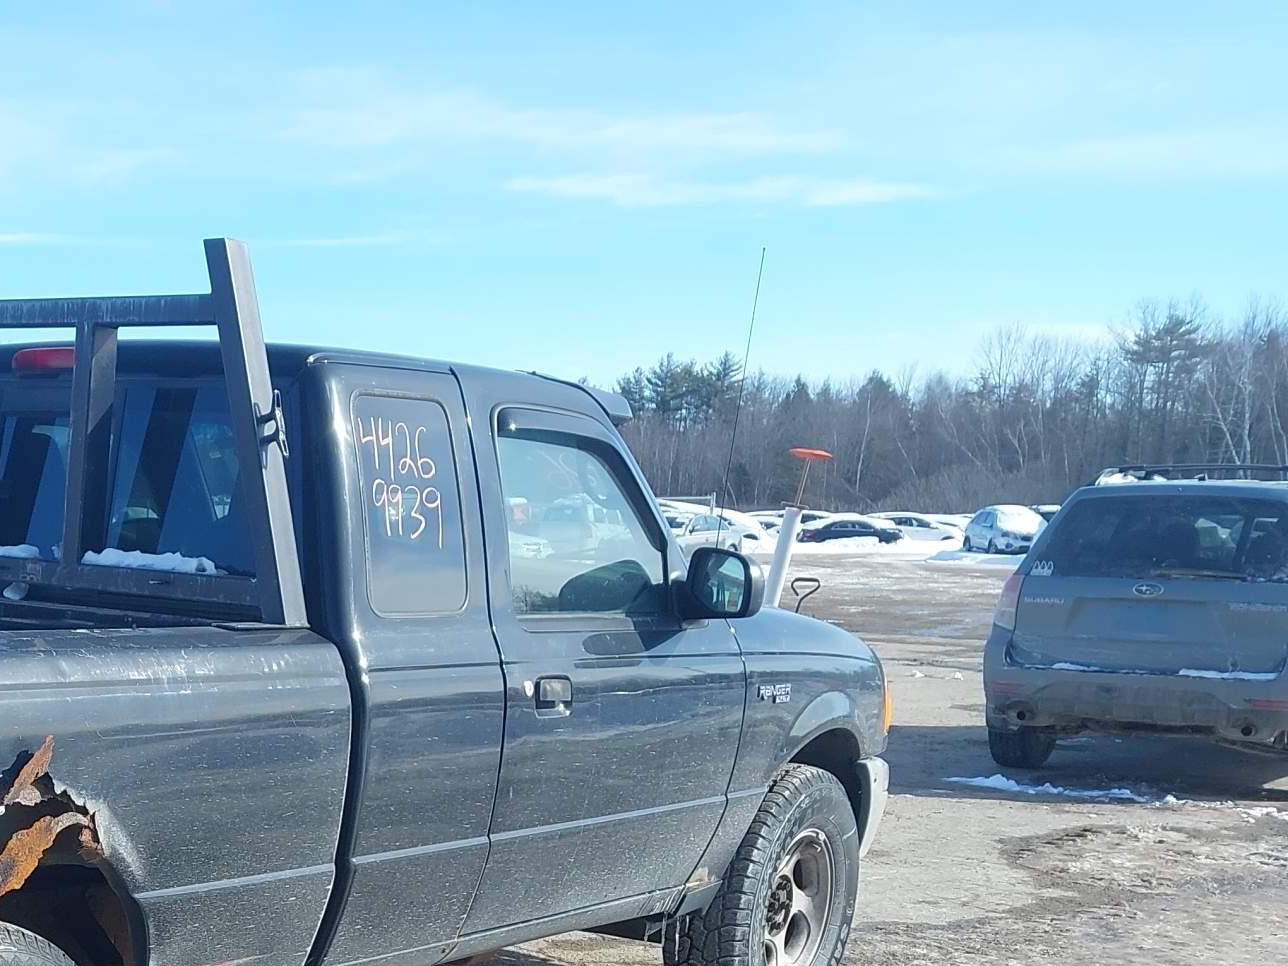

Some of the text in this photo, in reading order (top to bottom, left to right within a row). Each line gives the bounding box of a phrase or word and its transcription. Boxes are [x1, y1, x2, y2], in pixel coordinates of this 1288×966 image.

[357, 416, 436, 481] 4426
[372, 478, 443, 549] 9939
[757, 683, 792, 700] RANGER
